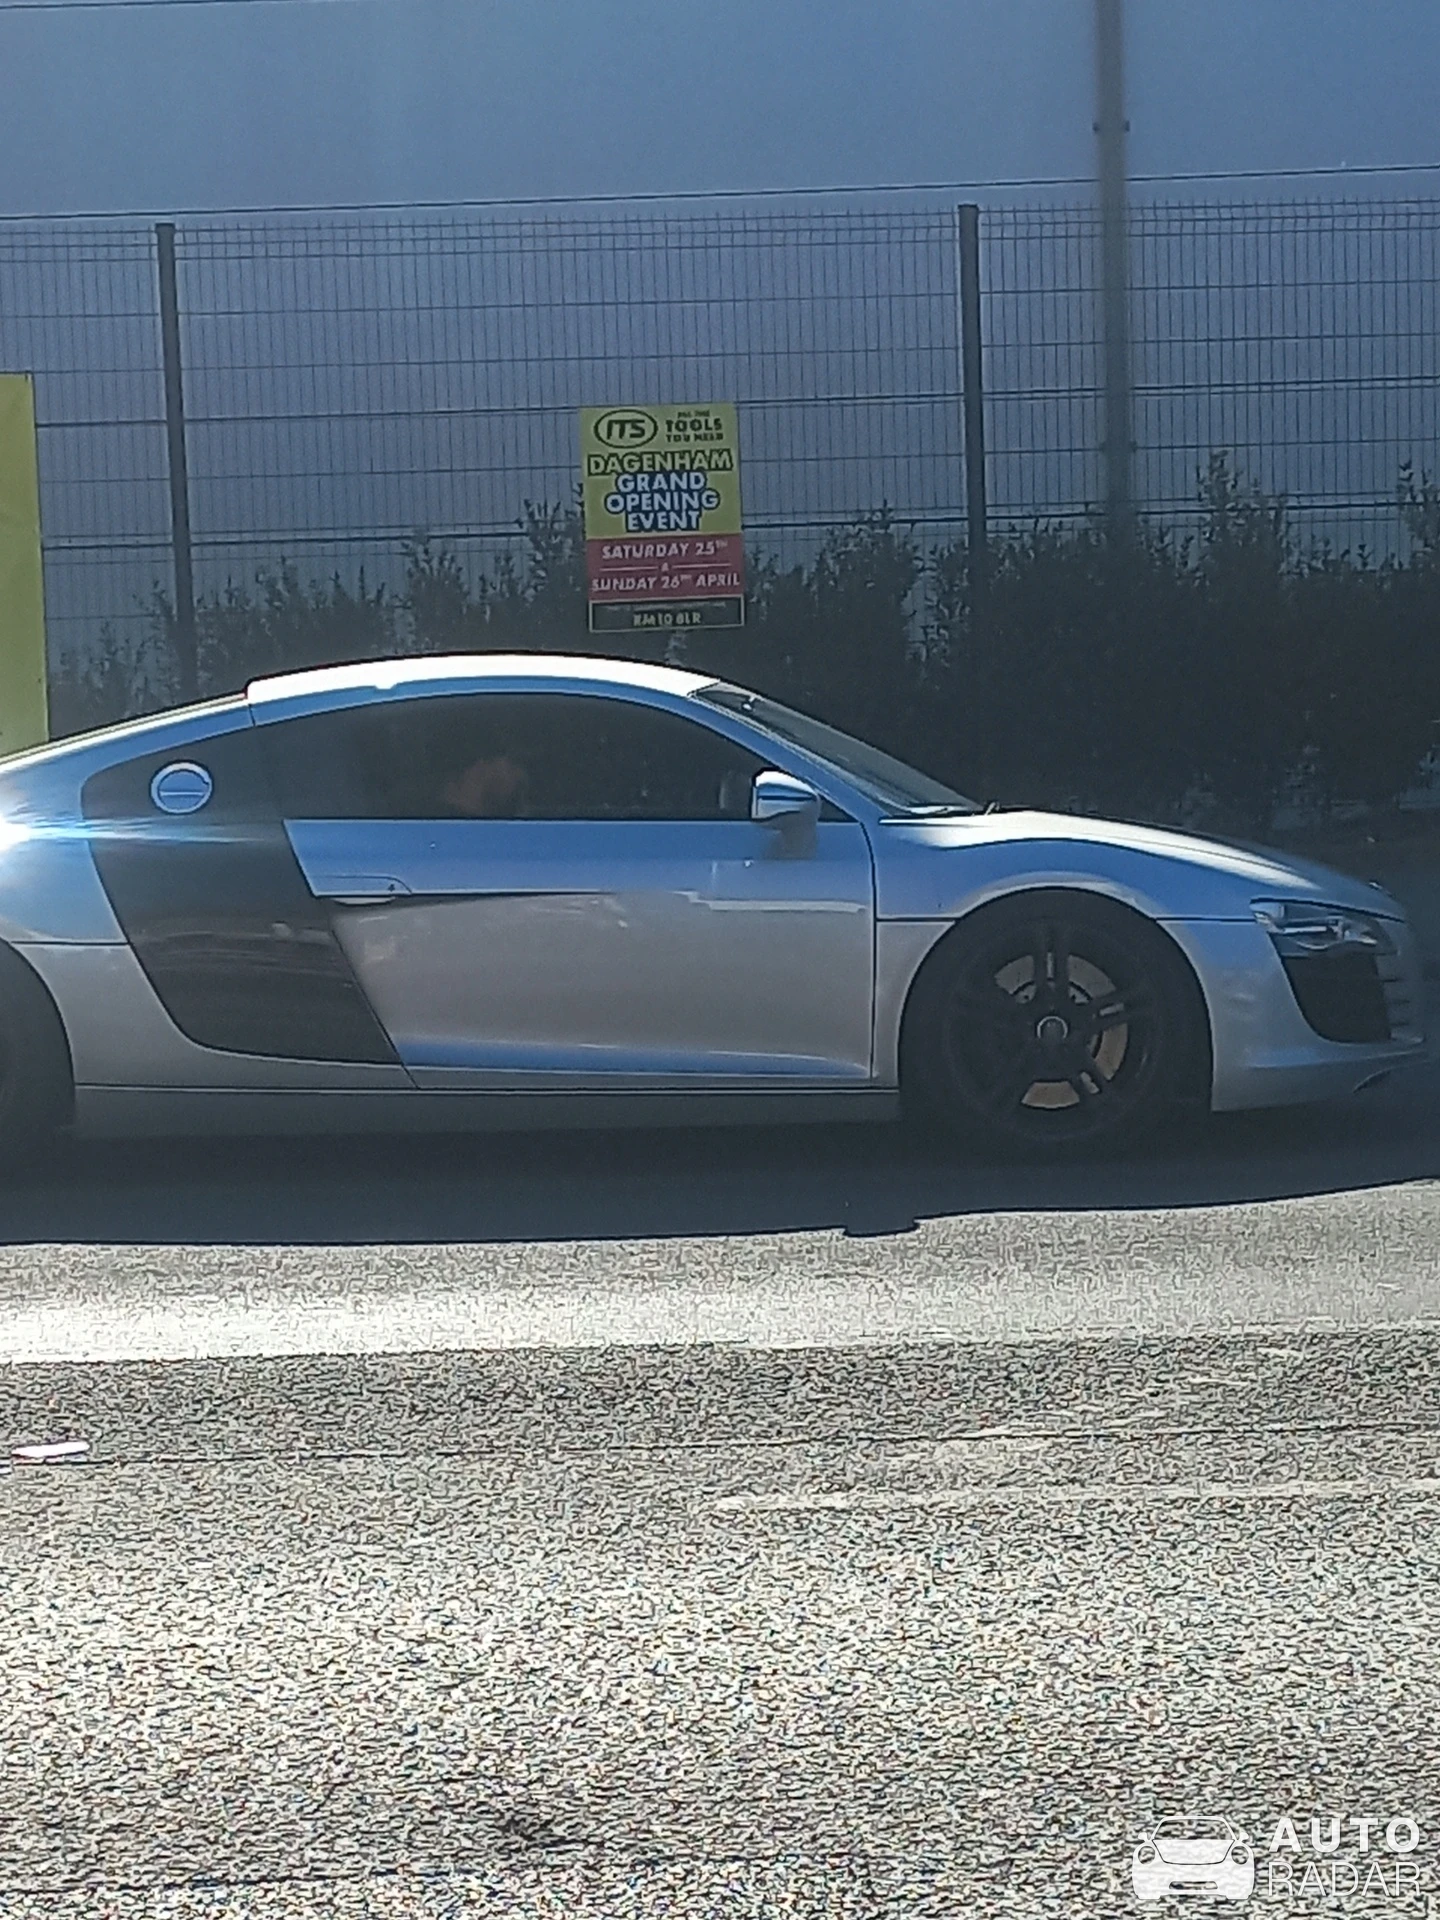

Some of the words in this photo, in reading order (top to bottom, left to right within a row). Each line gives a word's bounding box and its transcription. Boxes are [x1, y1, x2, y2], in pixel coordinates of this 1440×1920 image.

[606, 419, 646, 440] ITS
[666, 418, 723, 432] TOOLS
[588, 450, 733, 476] DAGENHAM
[616, 472, 706, 493] GRAND
[606, 490, 719, 513] OPENING
[627, 511, 700, 531] EVENT
[602, 543, 689, 559] SATURDAY
[592, 577, 656, 591] SUNDAY
[696, 573, 740, 587] APRIL
